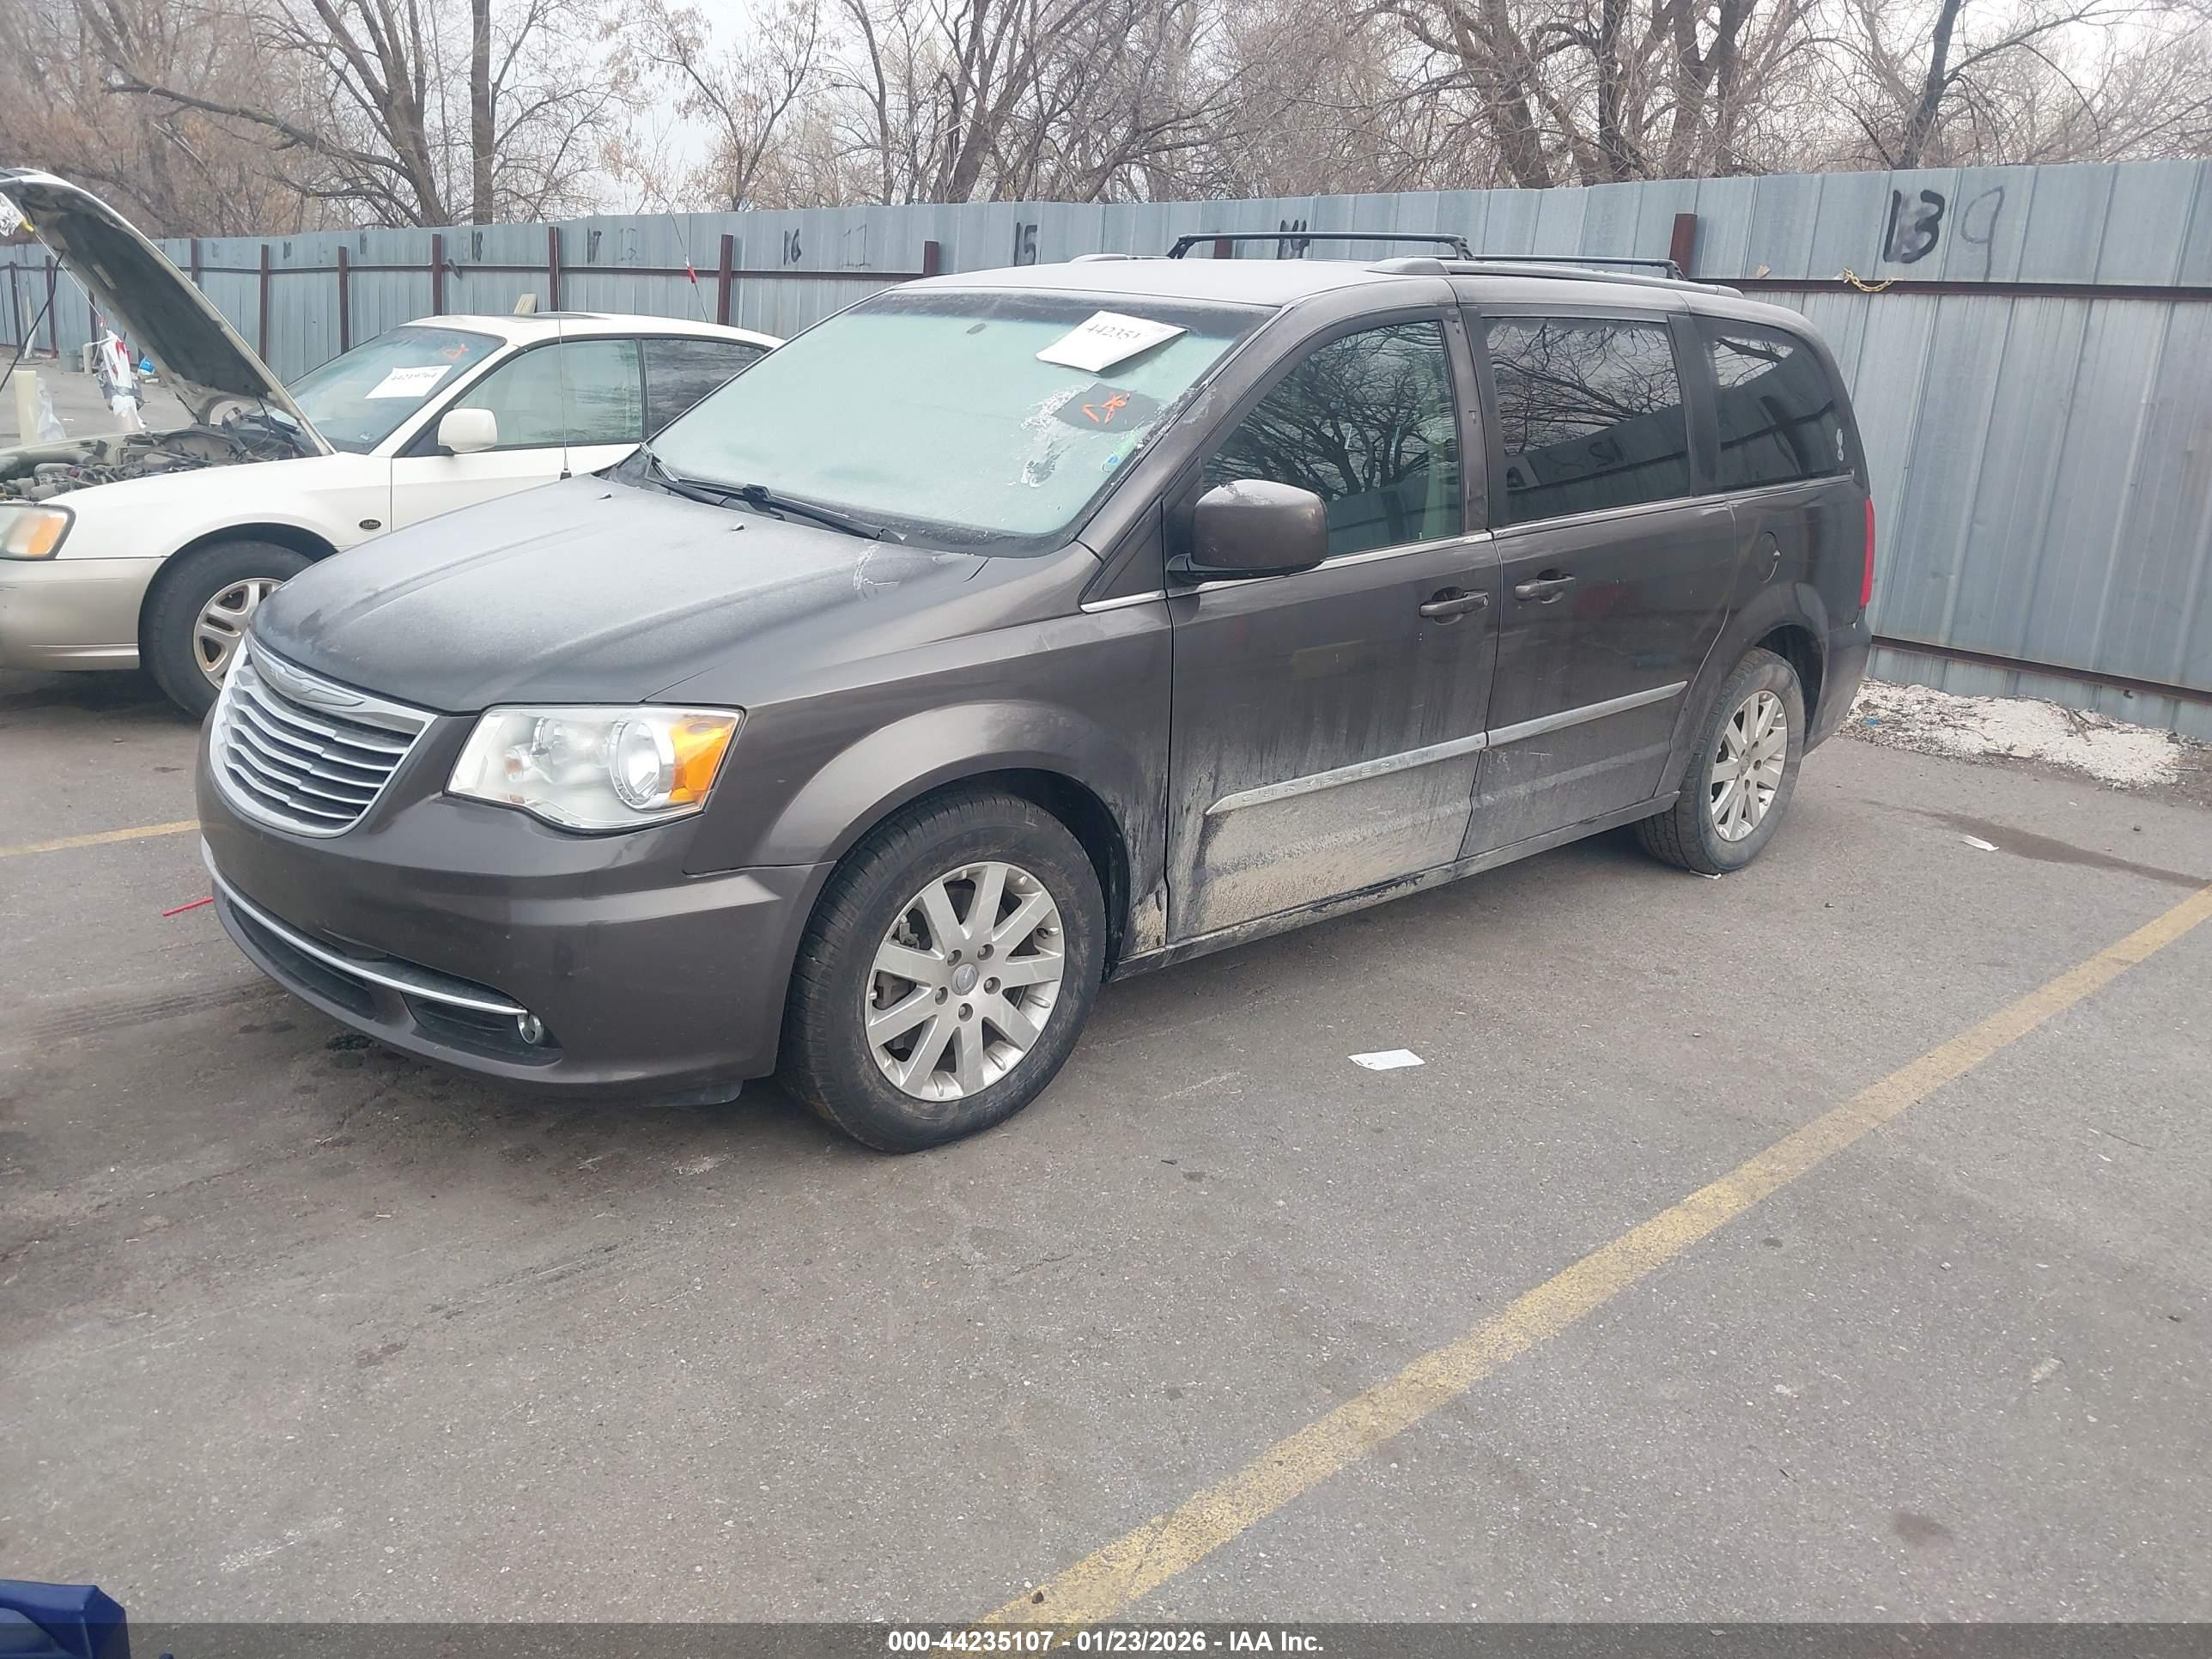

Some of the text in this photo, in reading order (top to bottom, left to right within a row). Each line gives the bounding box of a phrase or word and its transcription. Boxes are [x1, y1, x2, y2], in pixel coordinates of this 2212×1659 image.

[783, 228, 802, 265] 16
[1013, 222, 1038, 266] 15
[1243, 762, 1391, 804] CHRYSLER
